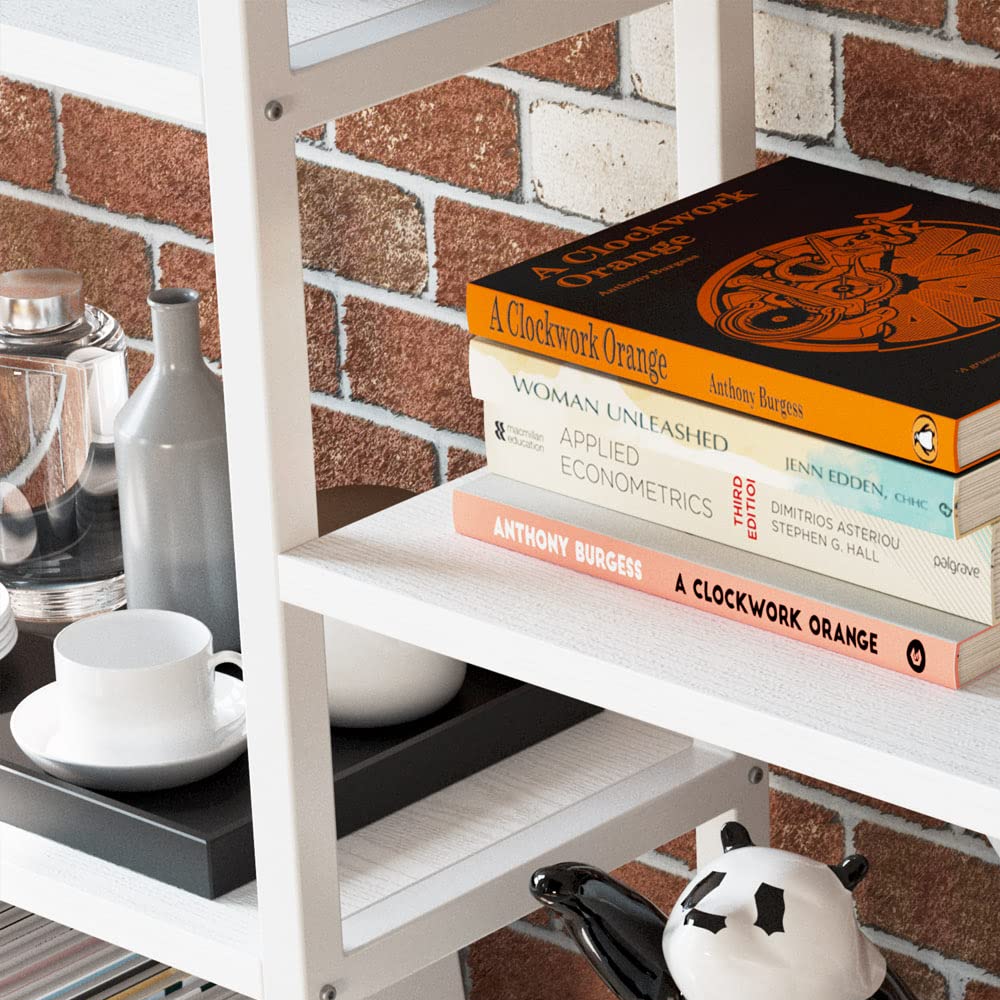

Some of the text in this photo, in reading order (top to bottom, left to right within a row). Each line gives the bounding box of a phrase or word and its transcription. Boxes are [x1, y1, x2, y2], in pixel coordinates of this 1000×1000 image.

[531, 189, 759, 281] A Clockwork
[556, 235, 696, 288] Orange
[489, 296, 668, 385] A Clockwork Orange
[512, 375, 729, 452] WOMAN UNLEASHED
[709, 372, 805, 420] Anthony Burgess
[507, 435, 545, 453] education
[560, 427, 641, 467] APPLIED
[560, 455, 714, 519] ECONOMETRICS
[732, 475, 744, 527] THIRD
[785, 456, 928, 510] JENN EDDEN, CHHC
[492, 515, 644, 581] ANTHONY BURGESS
[771, 501, 900, 550] DIMITRIOS ASTERIOU
[771, 519, 880, 563] STEPHEN G. HALL
[933, 555, 981, 579] palgrave
[674, 572, 880, 656] A CLOCKWORK ORANGE
